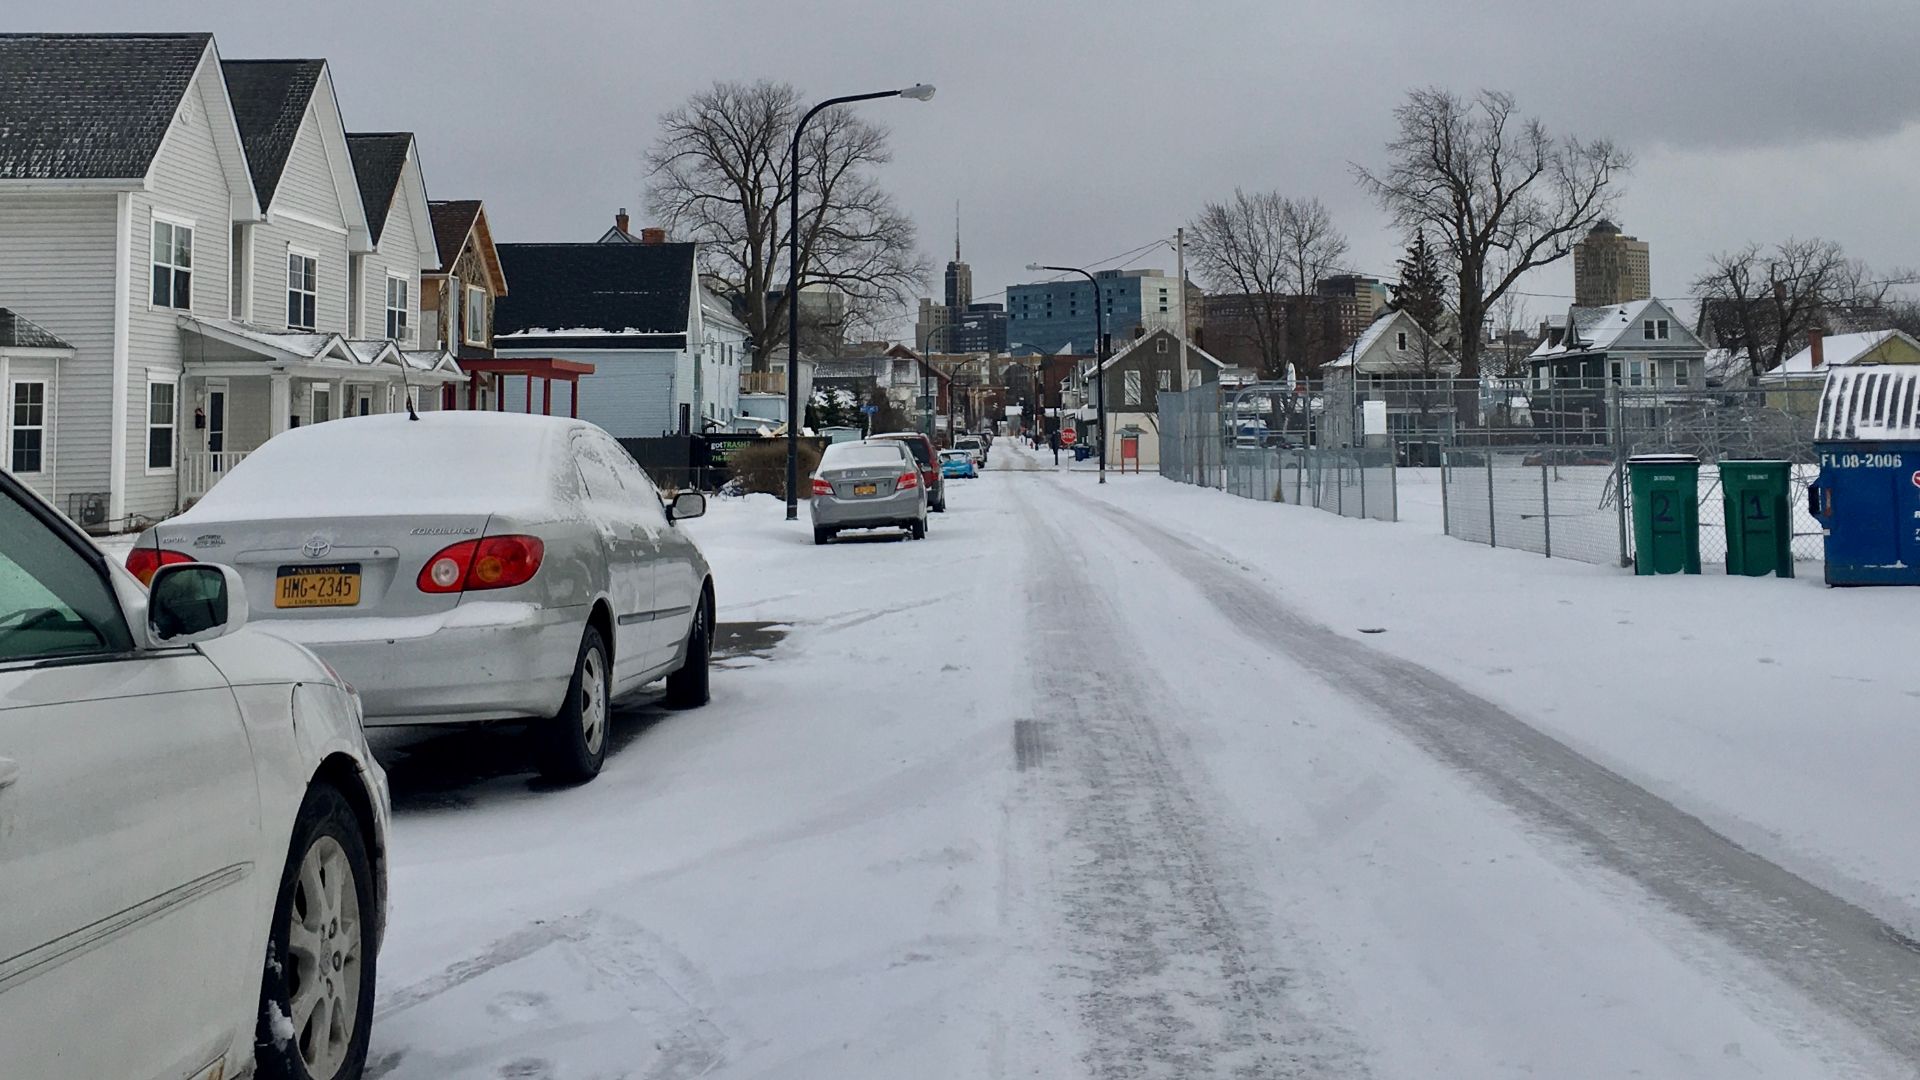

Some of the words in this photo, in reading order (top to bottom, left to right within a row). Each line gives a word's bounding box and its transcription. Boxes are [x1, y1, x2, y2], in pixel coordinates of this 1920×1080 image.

[1654, 494, 1674, 521] 2
[1747, 495, 1769, 519] 1
[297, 567, 317, 575] NEW
[319, 566, 340, 574] YORK
